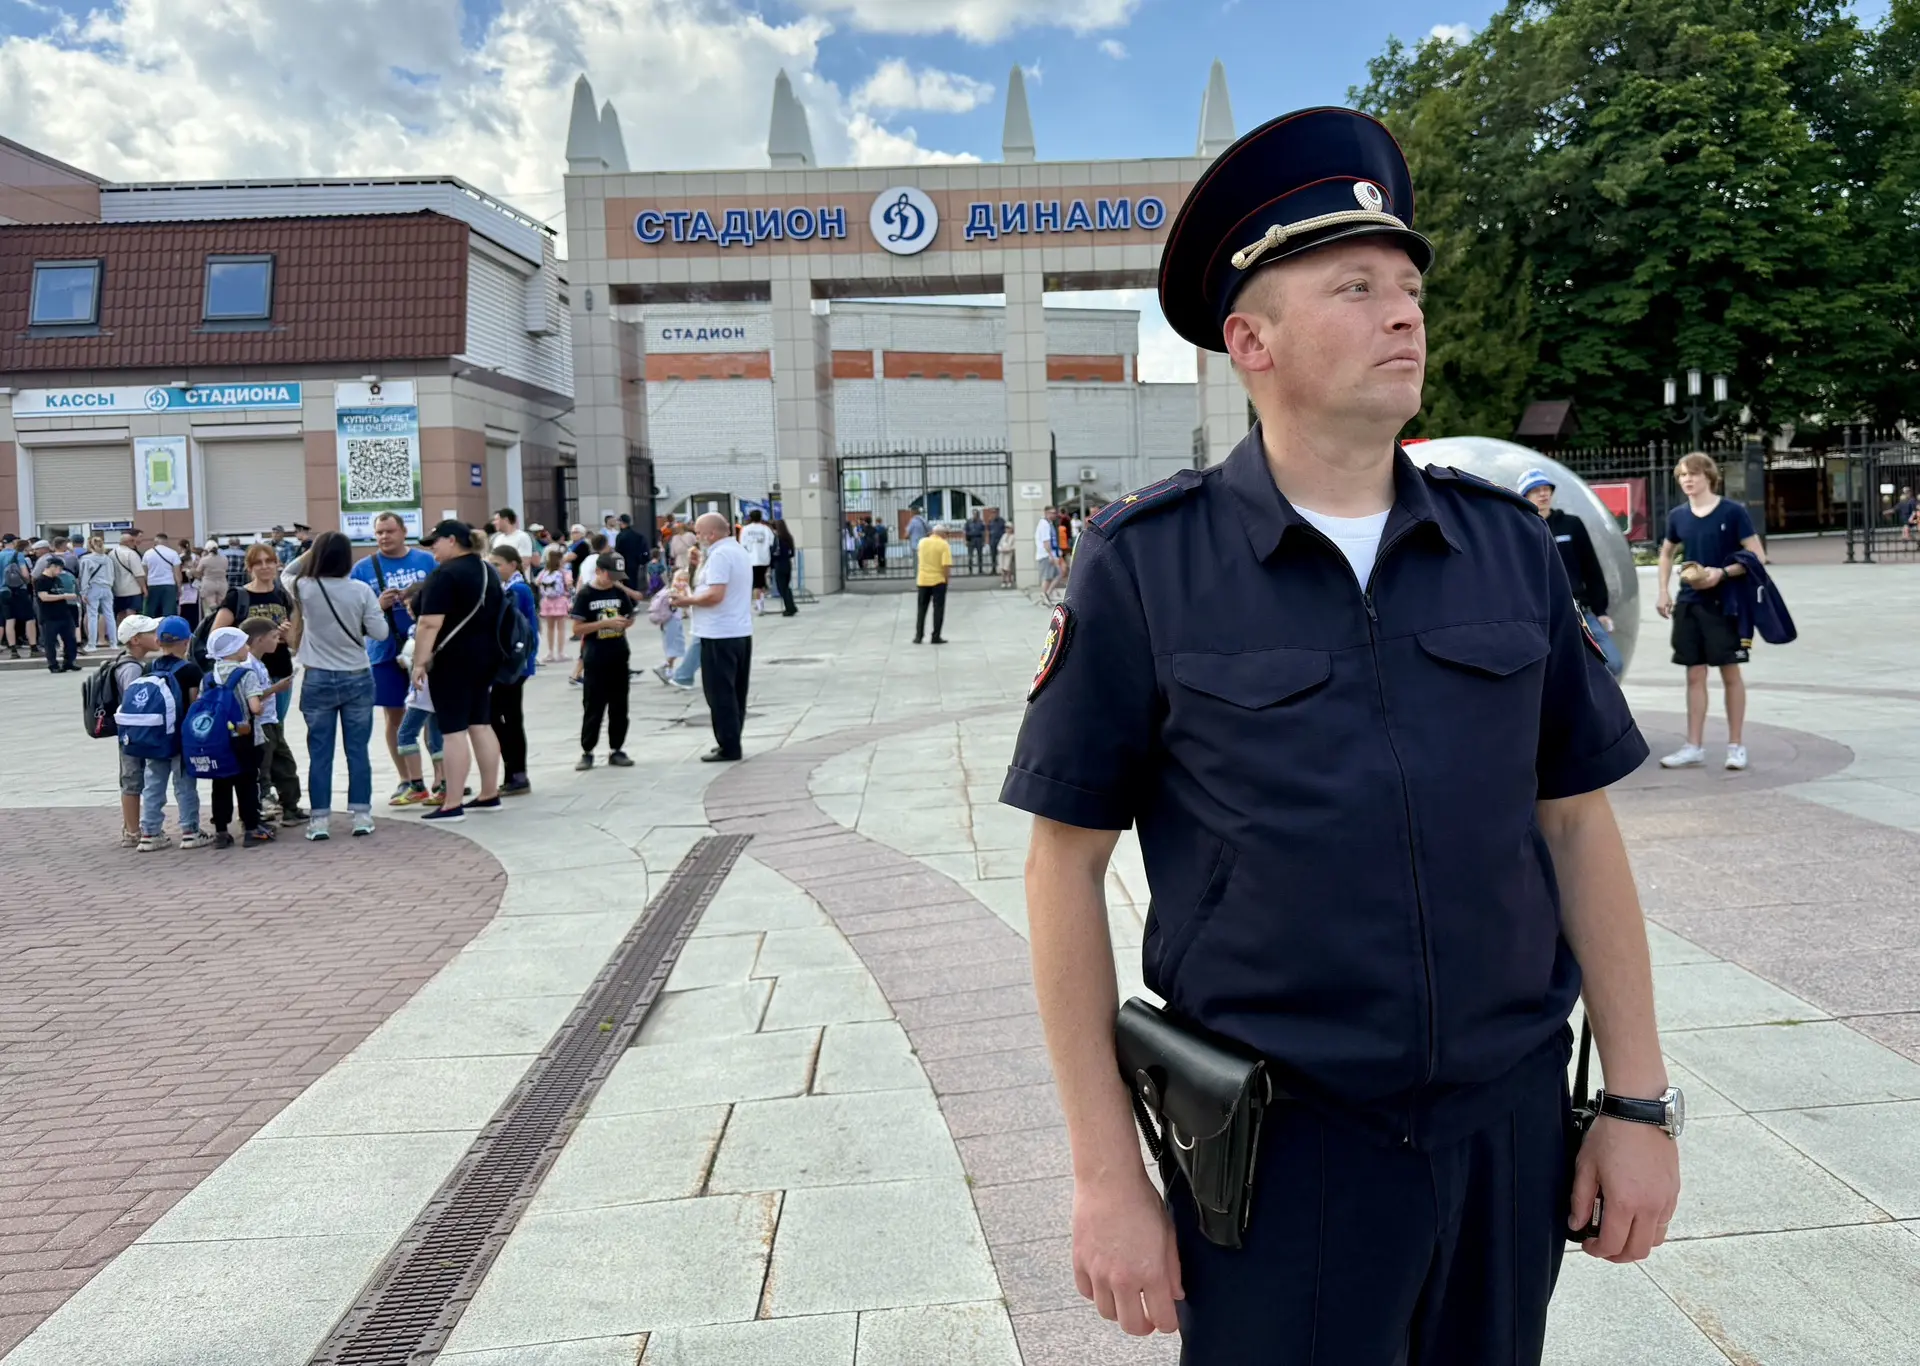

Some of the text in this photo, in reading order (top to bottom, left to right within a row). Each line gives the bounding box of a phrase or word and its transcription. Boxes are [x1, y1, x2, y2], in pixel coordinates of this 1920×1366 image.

[634, 206, 847, 247] СТАДИОН
[963, 196, 1167, 241] ДИНАМО
[662, 327, 745, 341] СТАДИОН
[46, 393, 115, 408] КАССЫ
[185, 386, 291, 404] СТАДИОНА
[343, 414, 380, 424] КУПИТЬ
[347, 422, 408, 433] БЕЗ ОЧЕРЕДИ
